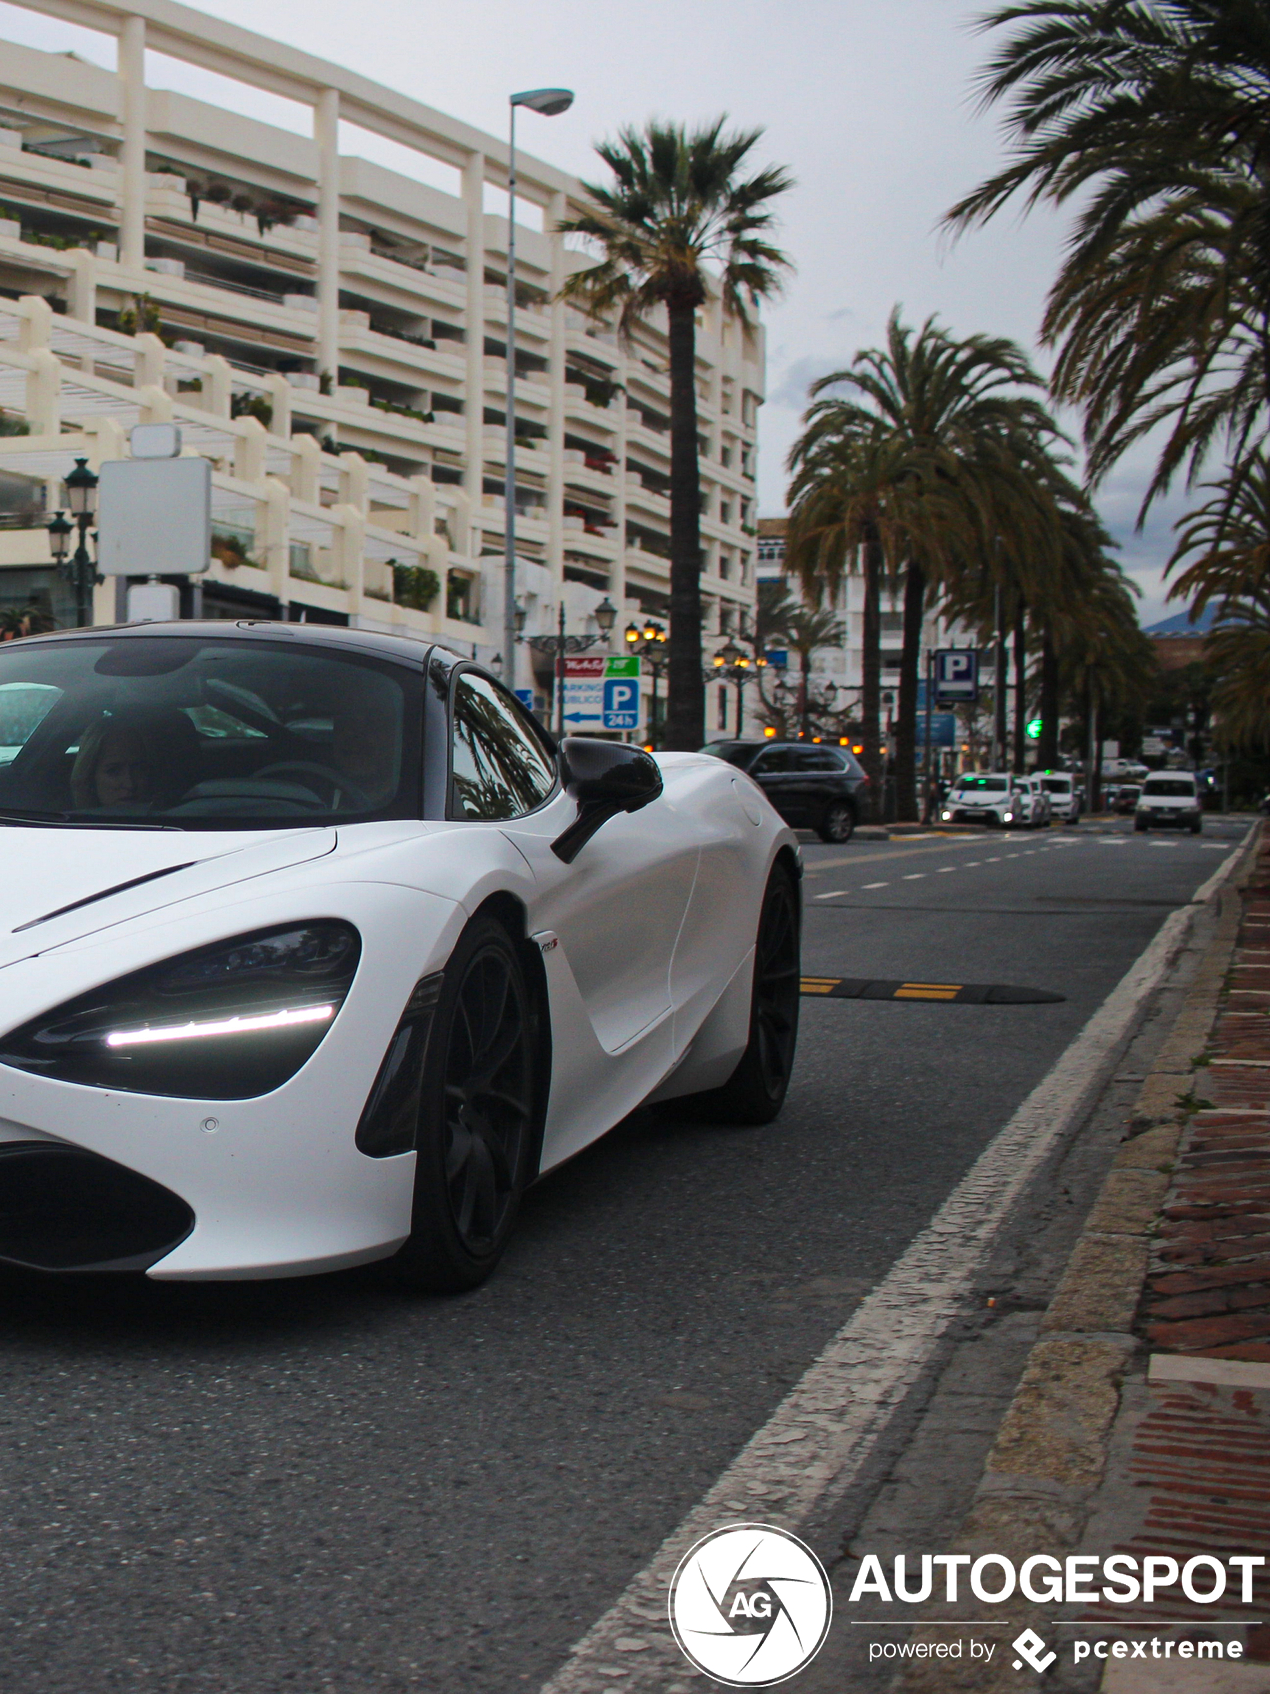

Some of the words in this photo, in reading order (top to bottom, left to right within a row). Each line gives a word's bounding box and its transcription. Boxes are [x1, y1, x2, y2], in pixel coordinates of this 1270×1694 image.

[944, 655, 968, 681] P
[557, 683, 604, 692] ARKING
[612, 685, 632, 711] P
[608, 714, 634, 727] 24h
